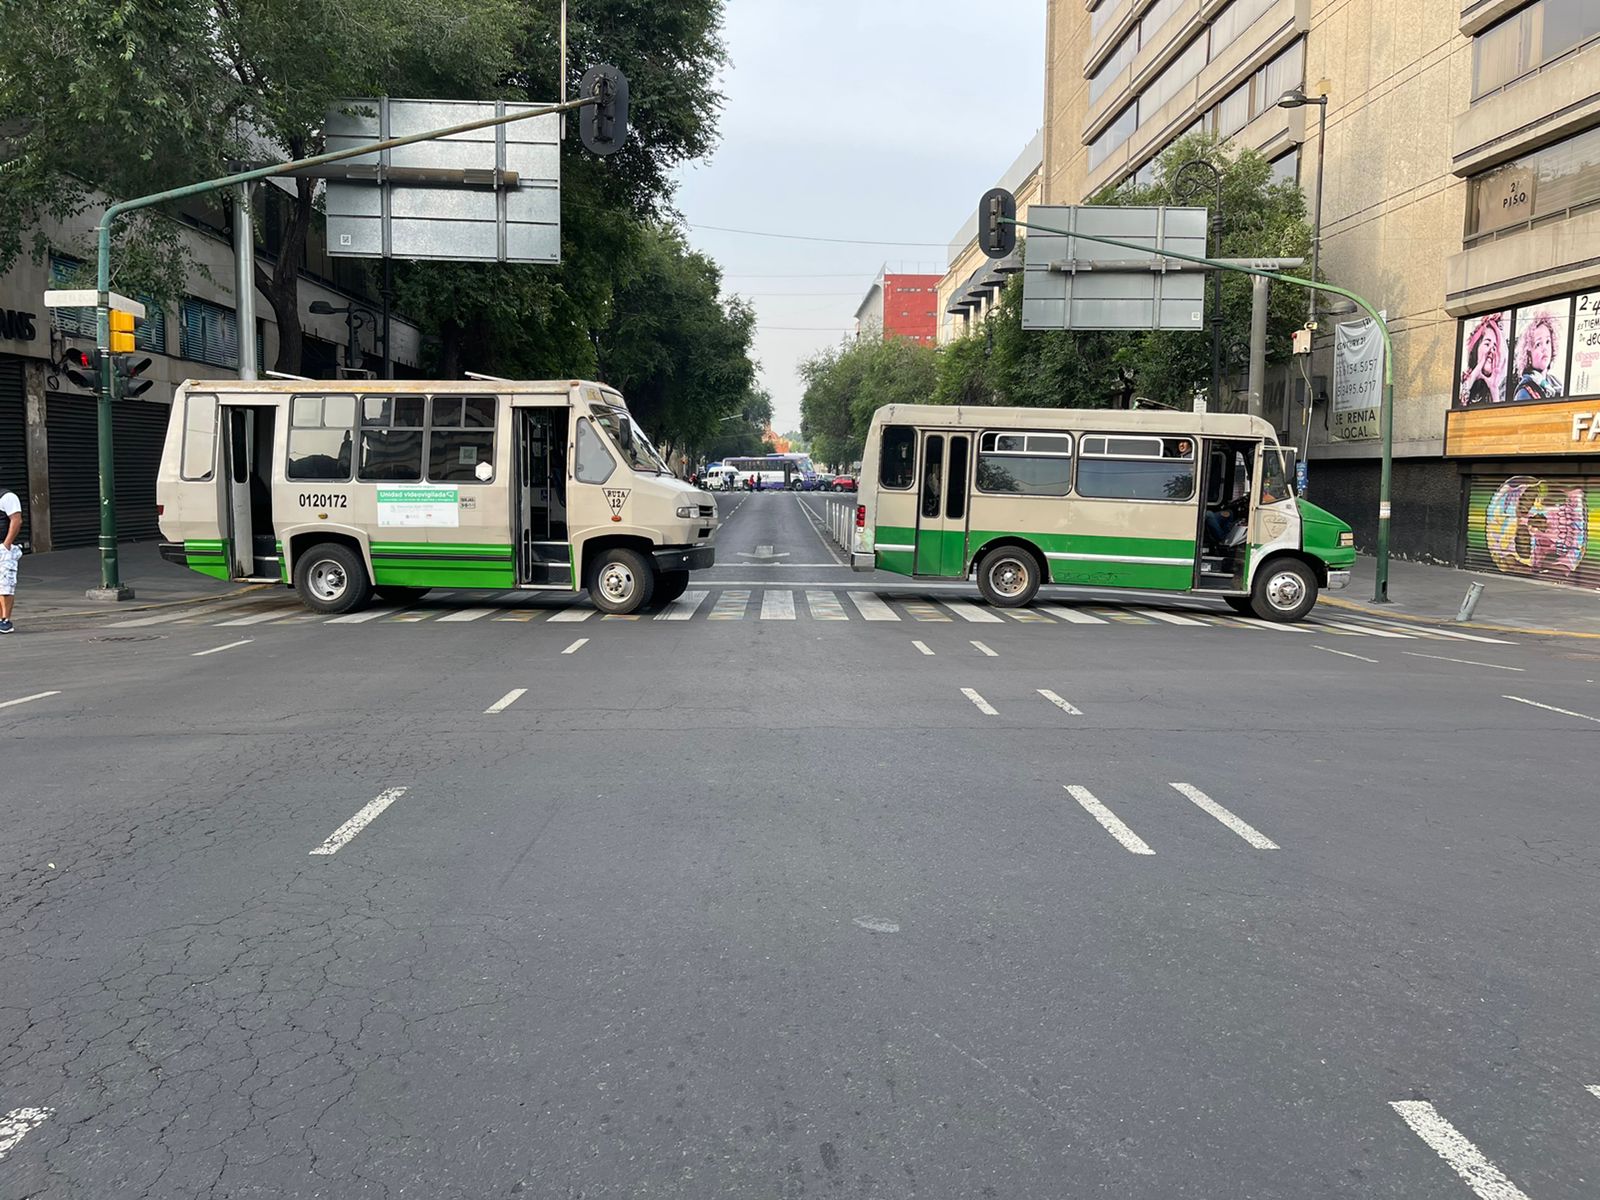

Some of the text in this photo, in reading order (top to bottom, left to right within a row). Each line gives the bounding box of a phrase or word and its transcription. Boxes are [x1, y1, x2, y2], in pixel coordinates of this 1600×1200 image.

[1503, 192, 1526, 208] PISO
[1335, 410, 1376, 425] SE RENTA
[1341, 426, 1368, 439] LOCAL
[404, 491, 446, 499] videovigilada
[607, 490, 626, 498] RUTA
[299, 494, 347, 508] 0120172
[612, 499, 621, 508] 12
